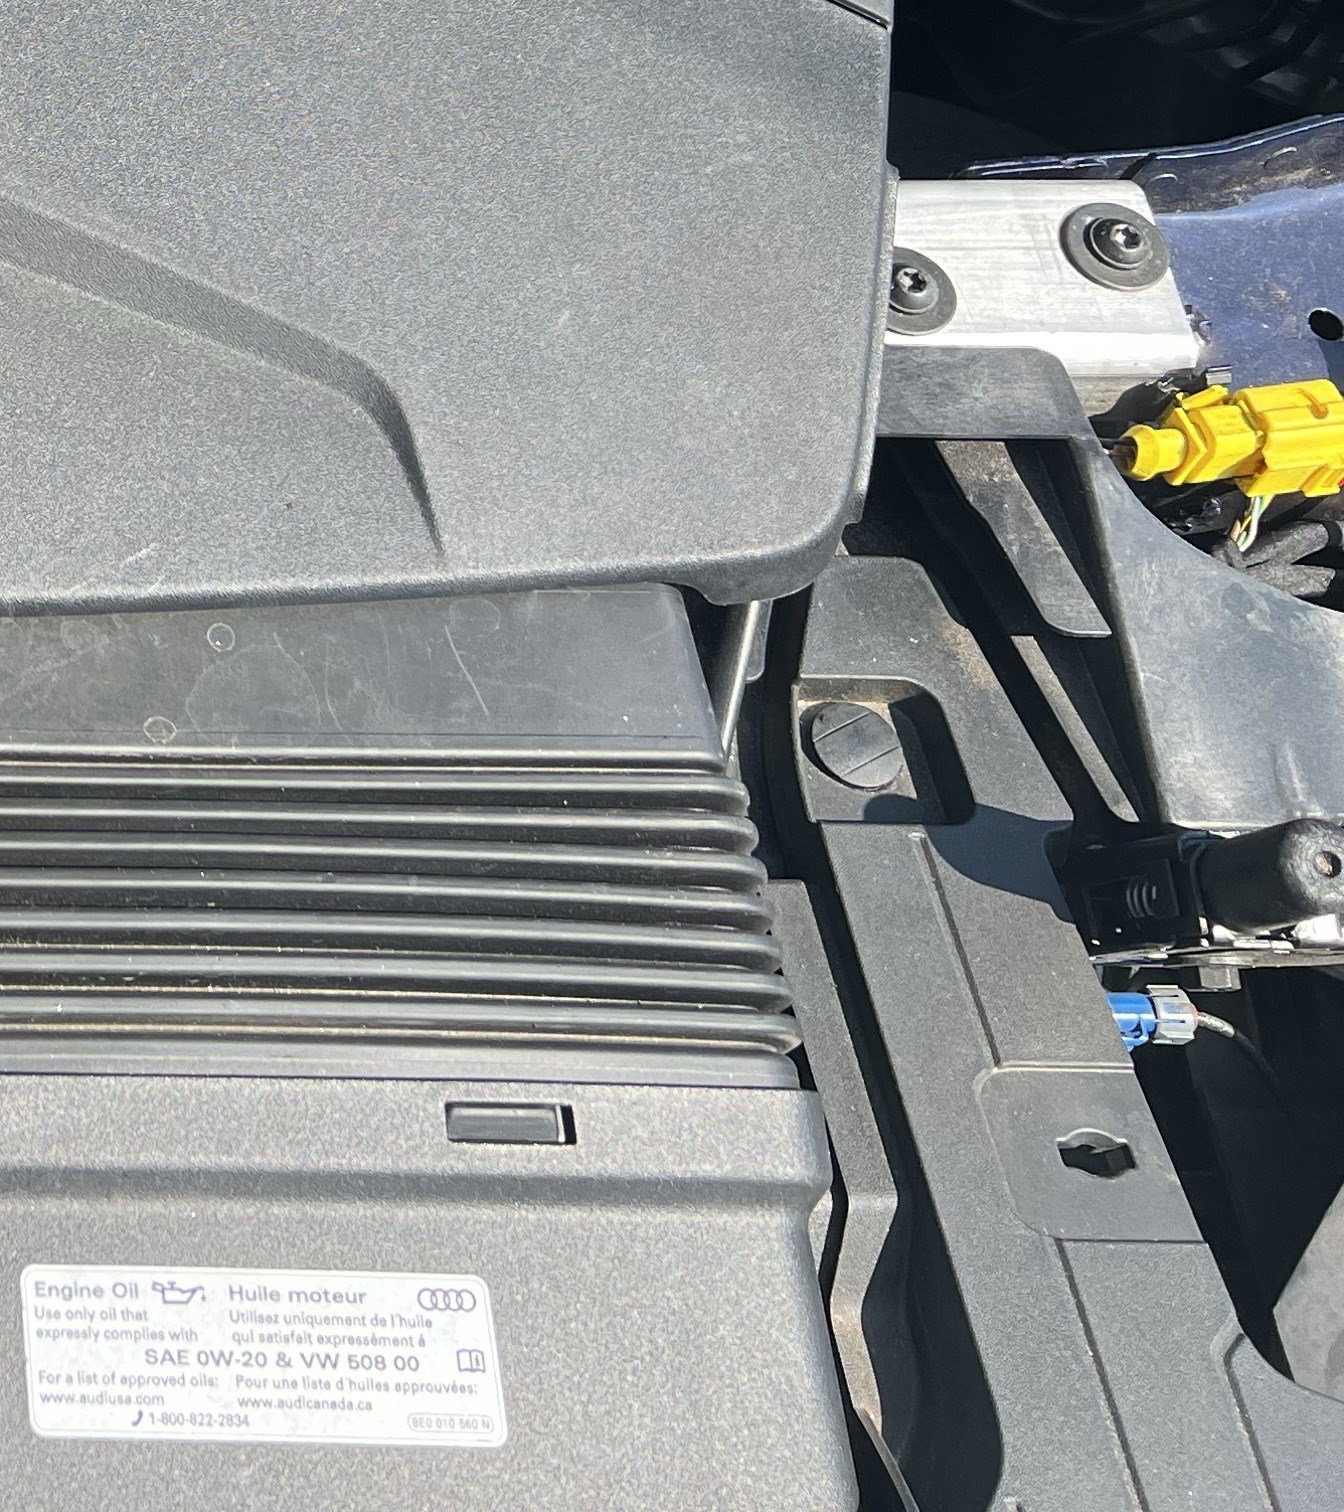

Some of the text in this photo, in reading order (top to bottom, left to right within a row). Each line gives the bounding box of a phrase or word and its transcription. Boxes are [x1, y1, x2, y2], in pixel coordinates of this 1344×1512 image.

[34, 1281, 139, 1301] Engine Oil
[228, 1285, 367, 1304] Huile moteur
[34, 1306, 148, 1323] Use only oil that
[229, 1309, 280, 1324] Utilisez
[284, 1312, 367, 1329] uniquement
[370, 1314, 387, 1326] de
[36, 1326, 198, 1343] expressly complies with
[232, 1330, 255, 1344] qui
[258, 1331, 313, 1345] satisfait
[317, 1332, 414, 1349] expressément
[144, 1349, 420, 1372] SAE 0W-20 & VW 508 00
[38, 1370, 219, 1388] For a list of approved oils:
[235, 1374, 269, 1389] Pour
[272, 1378, 298, 1390] une
[302, 1376, 331, 1391] liste
[40, 1391, 165, 1406] www.audiusa.com
[237, 1395, 373, 1411] www.audicanada.ca
